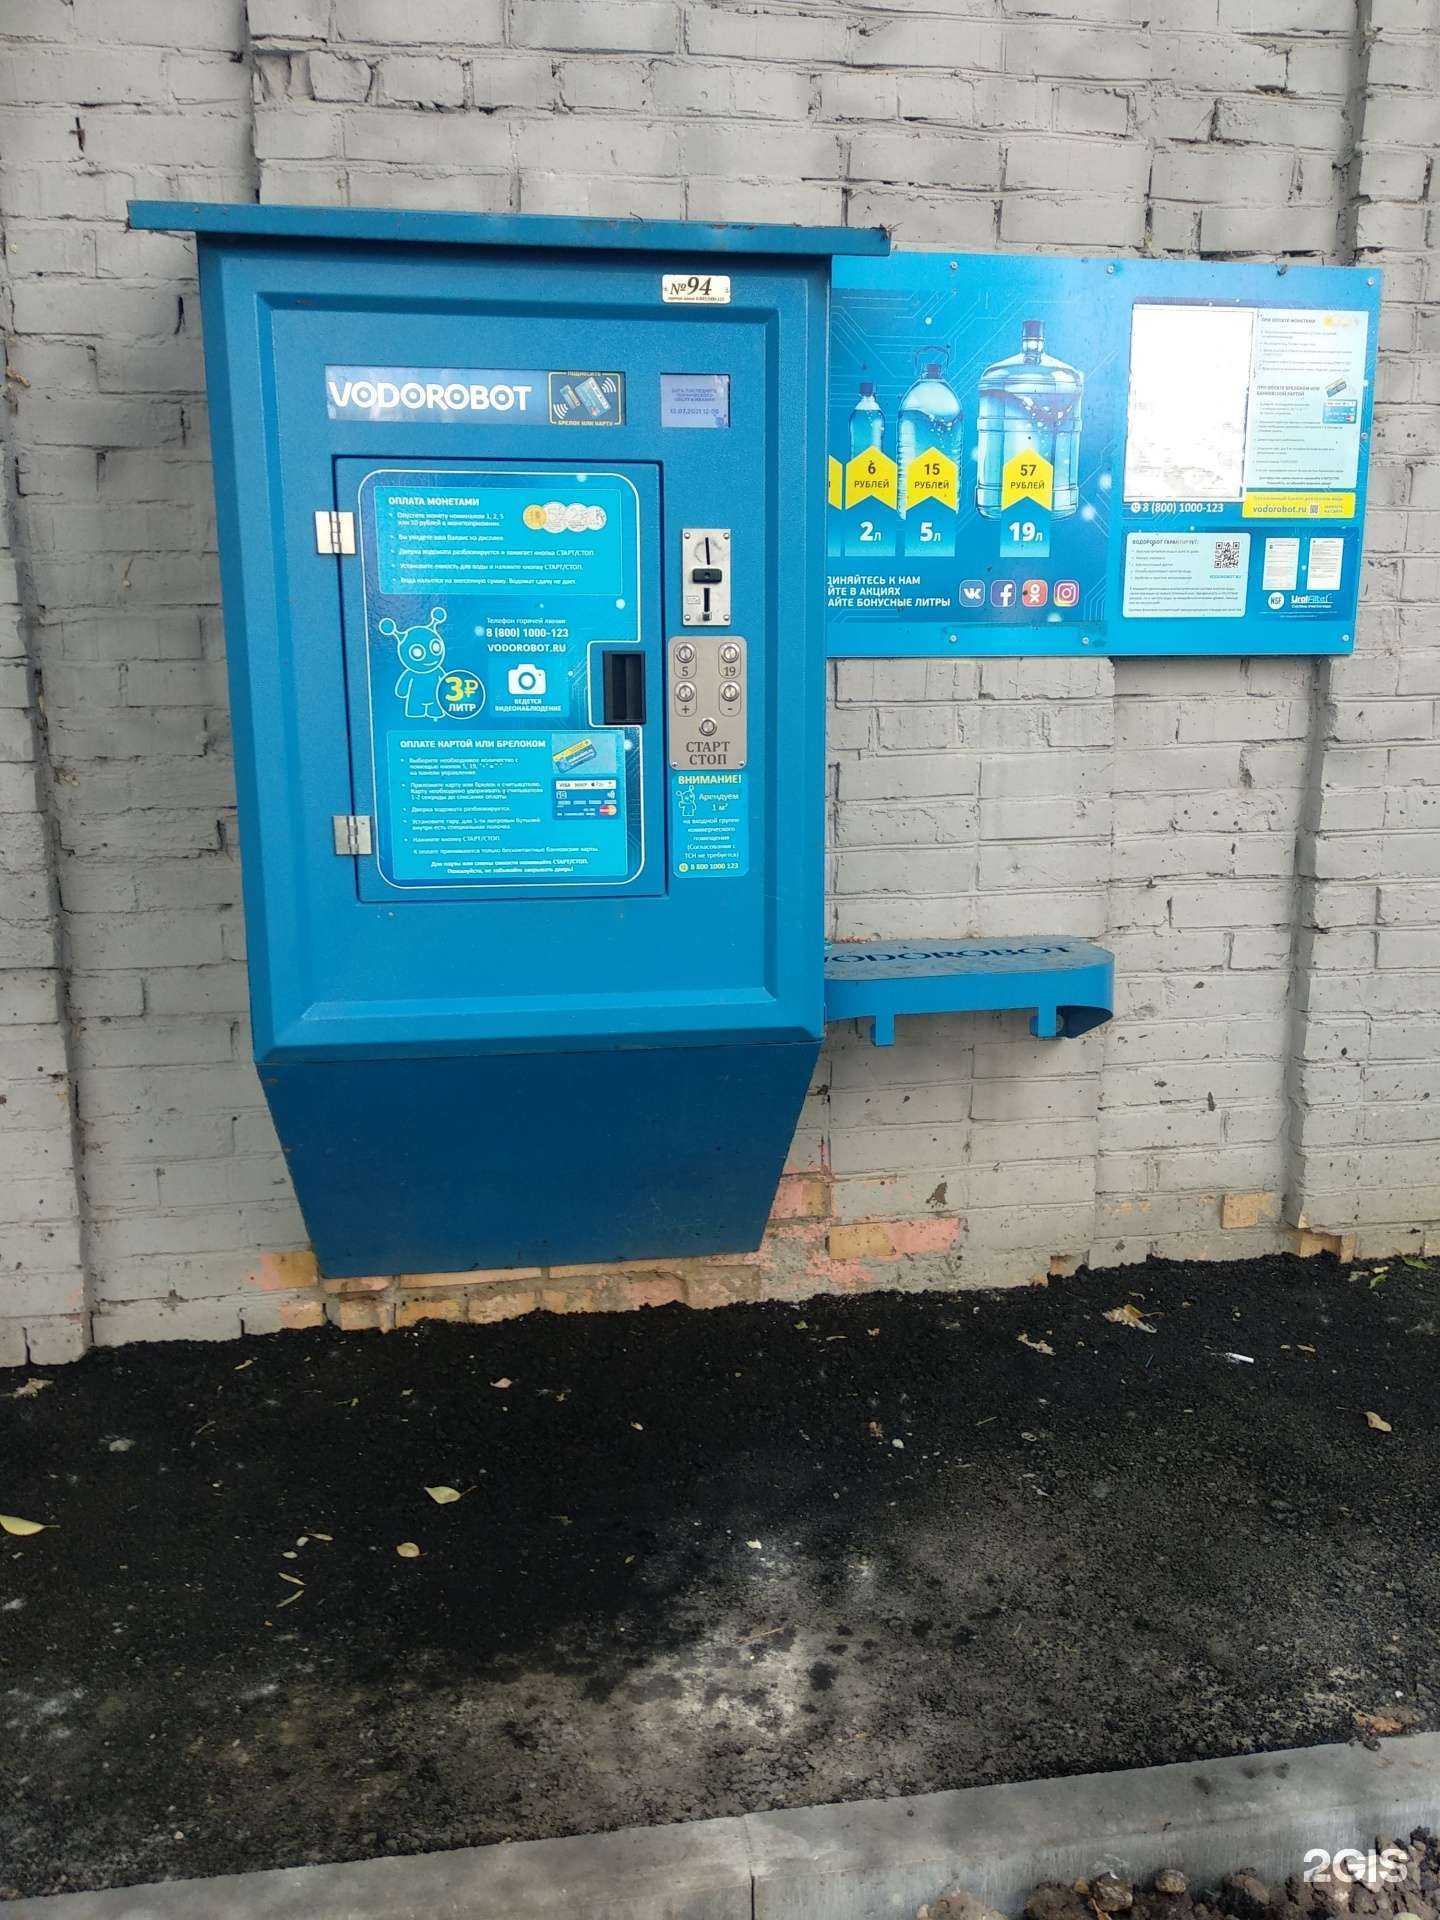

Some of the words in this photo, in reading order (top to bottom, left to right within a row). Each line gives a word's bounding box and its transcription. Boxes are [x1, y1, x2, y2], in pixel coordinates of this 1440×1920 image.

[328, 381, 532, 411] VODOROBOT
[868, 463, 875, 474] 6
[924, 463, 940, 475] 15
[1020, 464, 1036, 476] 57
[854, 478, 889, 489] РУБЛЕЙ
[914, 479, 949, 490] РУБЛЕЙ
[1010, 478, 1045, 490] РУБЛЕЙ
[388, 496, 425, 506] ОПЛАТА
[427, 497, 480, 506] МОНЕТАМИ
[1142, 503, 1149, 512] 8
[1151, 502, 1177, 514] (800)
[1179, 502, 1223, 513] 1000-123
[1253, 503, 1307, 513] vodorobot.ru
[889, 576, 896, 584] К
[898, 576, 921, 584] НАМ
[859, 587, 901, 597] АКЦИЯХ
[856, 598, 912, 607] БОНУСНЫЕ
[914, 598, 951, 607] ЛИТРЫ
[487, 617, 515, 625] Телефон
[486, 628, 493, 638] 8
[495, 627, 520, 639] (800)
[523, 628, 569, 638] 1000-123
[487, 643, 567, 653] VODOROBOT.RU
[681, 666, 689, 676] 5
[723, 666, 736, 676] 19
[448, 703, 477, 713] ЛИТР
[400, 740, 435, 748] ОПЛАТЕ
[438, 738, 473, 748] КАРТОЙ
[475, 740, 495, 748] ИЛИ
[496, 740, 546, 748] БРЕЛОКОМ
[685, 741, 730, 754] СТАРТ
[689, 754, 727, 765] СТОП
[678, 774, 742, 785] ВНИМАНИЕ!
[699, 792, 739, 801] Арендуем
